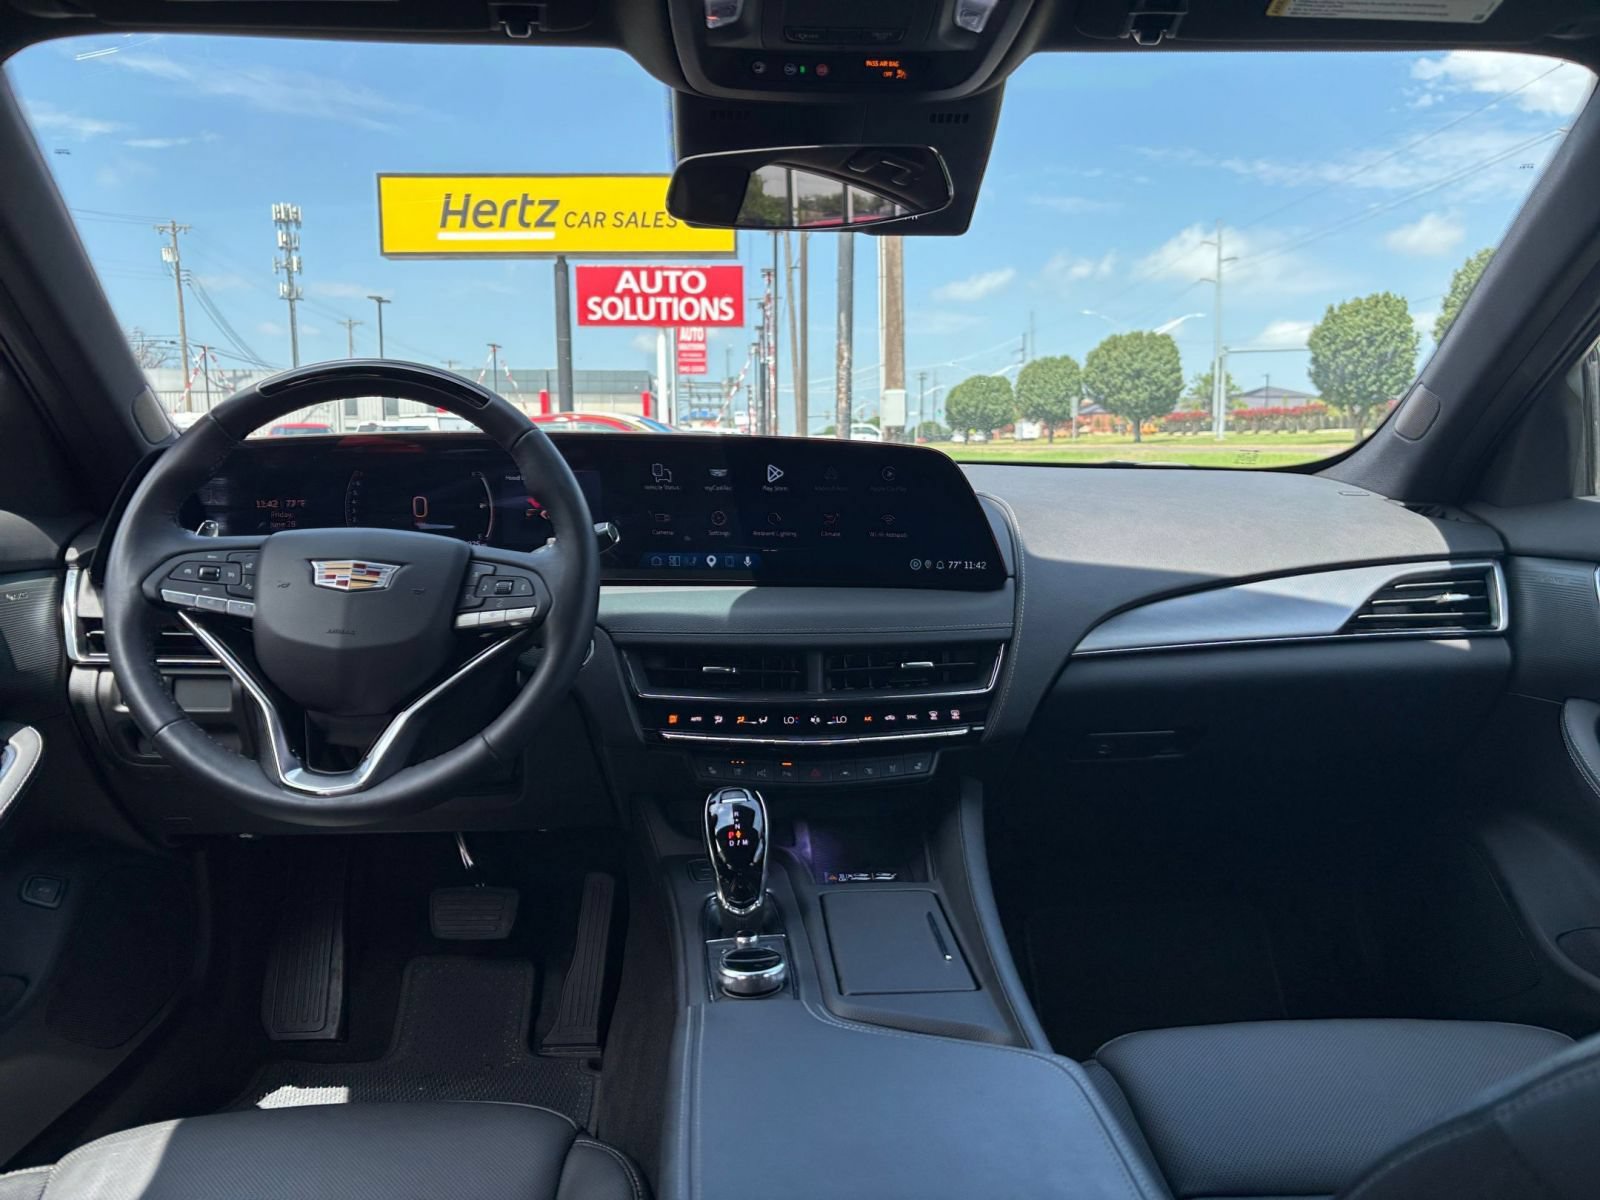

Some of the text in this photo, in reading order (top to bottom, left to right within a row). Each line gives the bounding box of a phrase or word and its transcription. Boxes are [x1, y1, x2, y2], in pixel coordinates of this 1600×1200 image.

[439, 192, 678, 229] Hertz CAR SALES
[614, 270, 707, 294] AUTO
[586, 296, 735, 322] SOLUTIONS
[680, 327, 704, 342] AUTO
[412, 496, 428, 517] 0
[948, 561, 987, 570] 77° 11:42
[783, 715, 848, 725] LO LO
